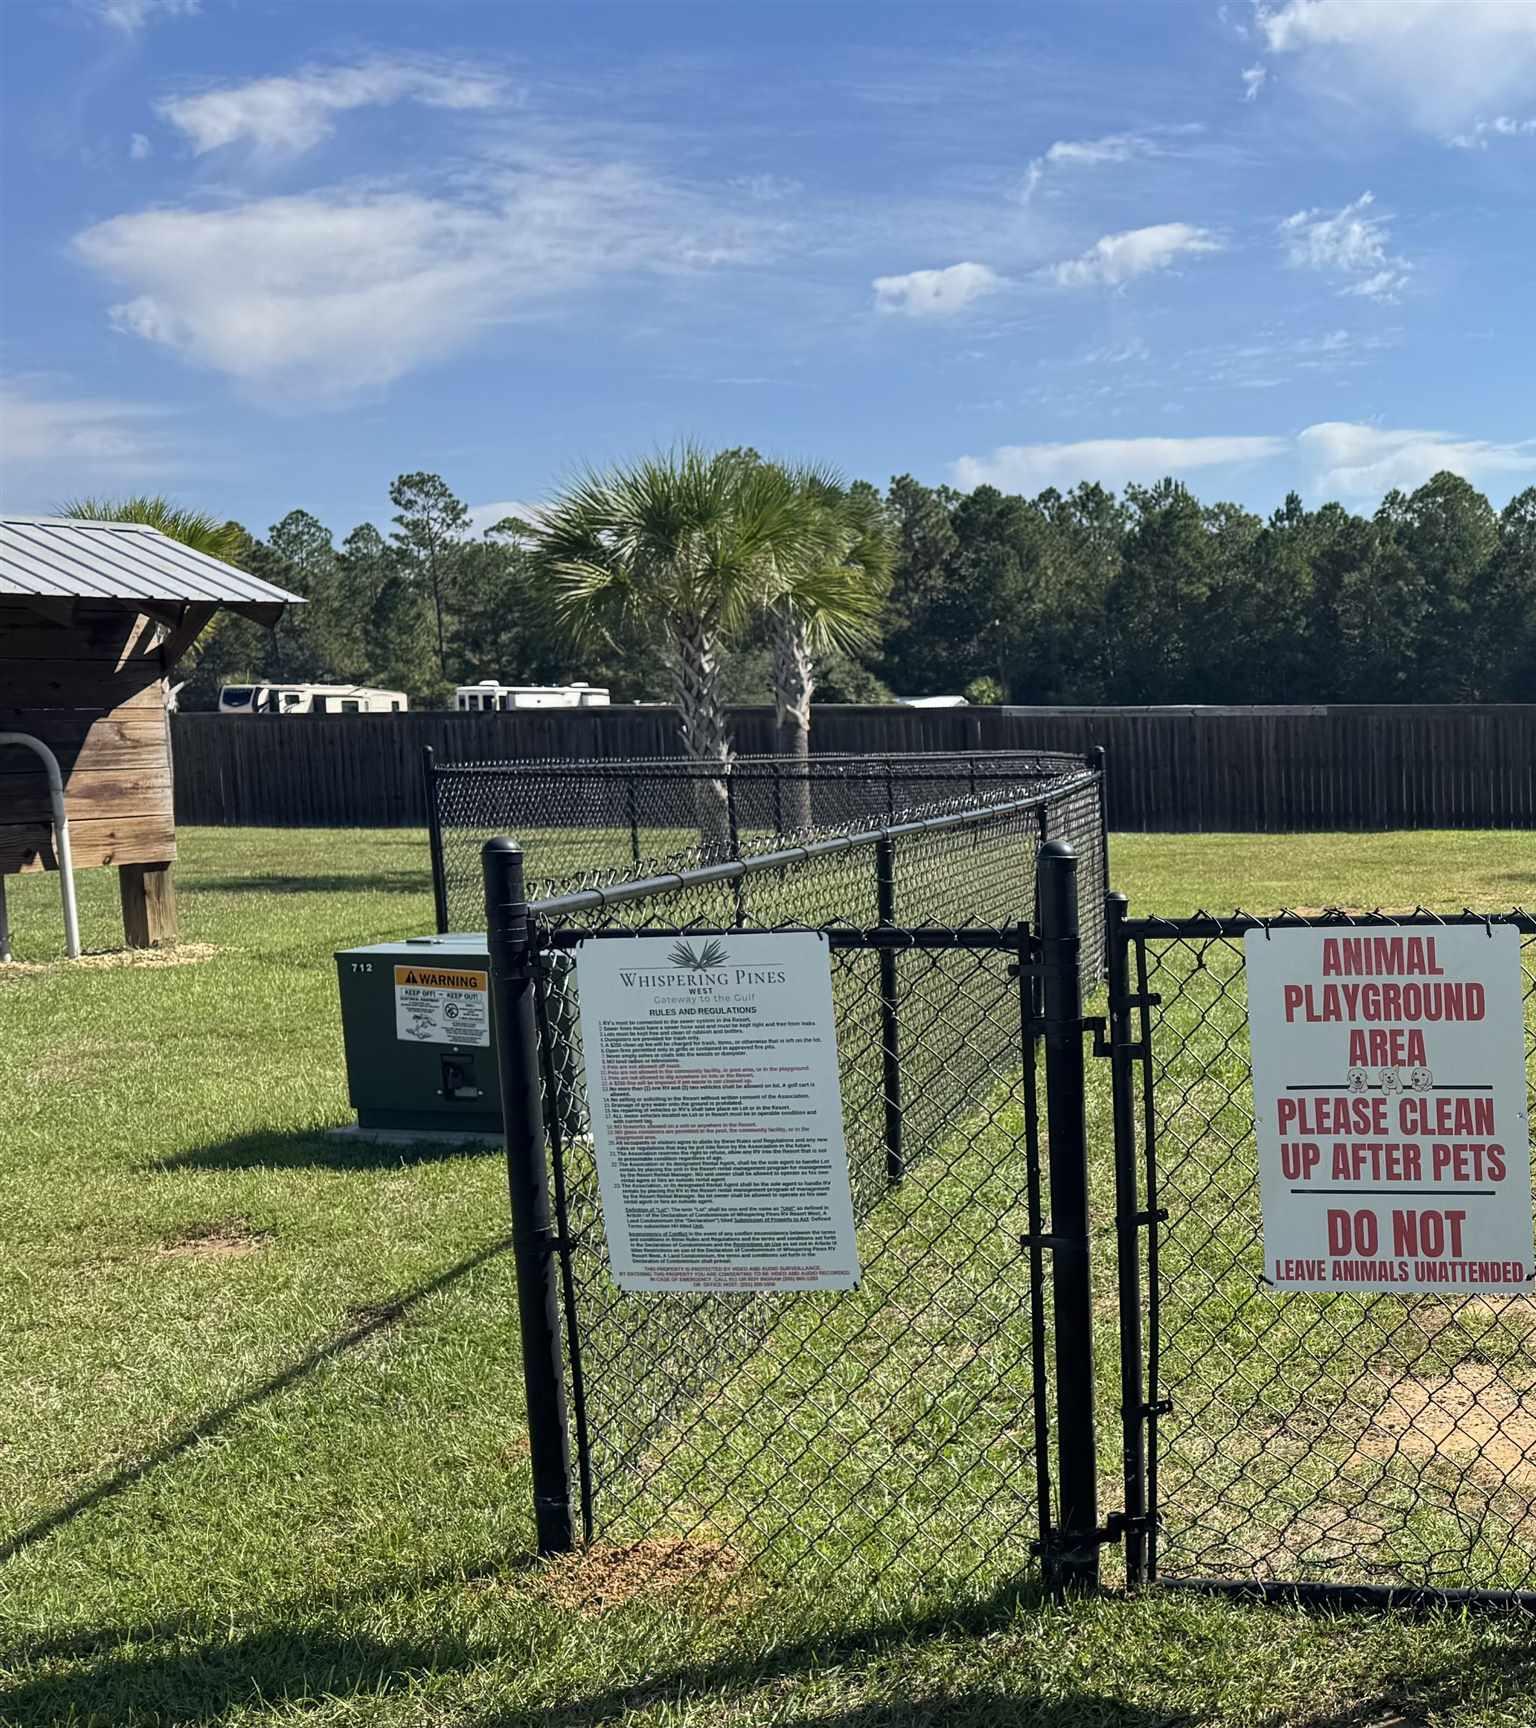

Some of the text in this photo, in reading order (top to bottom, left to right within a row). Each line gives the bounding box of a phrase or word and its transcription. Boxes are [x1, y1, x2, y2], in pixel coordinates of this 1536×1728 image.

[1322, 936, 1444, 976] ANIMAL
[352, 963, 373, 973] 712
[619, 969, 787, 987] WHISPERING PINES
[420, 973, 478, 988] WARNING
[688, 987, 713, 995] WEST
[654, 993, 756, 1005] Gateway to the Gulf
[1284, 982, 1486, 1022] PLAYGROUND
[649, 1008, 676, 1016] RULES
[698, 1006, 757, 1015] REGULATIONS
[1349, 1029, 1427, 1067] AREA
[1277, 1098, 1496, 1136] PLEASE CLEAN
[1281, 1143, 1507, 1182] UP AFTER PETS
[1327, 1208, 1466, 1258] DO NOT
[1276, 1260, 1524, 1283] LEAVE ANIMALS UNATTENDED
